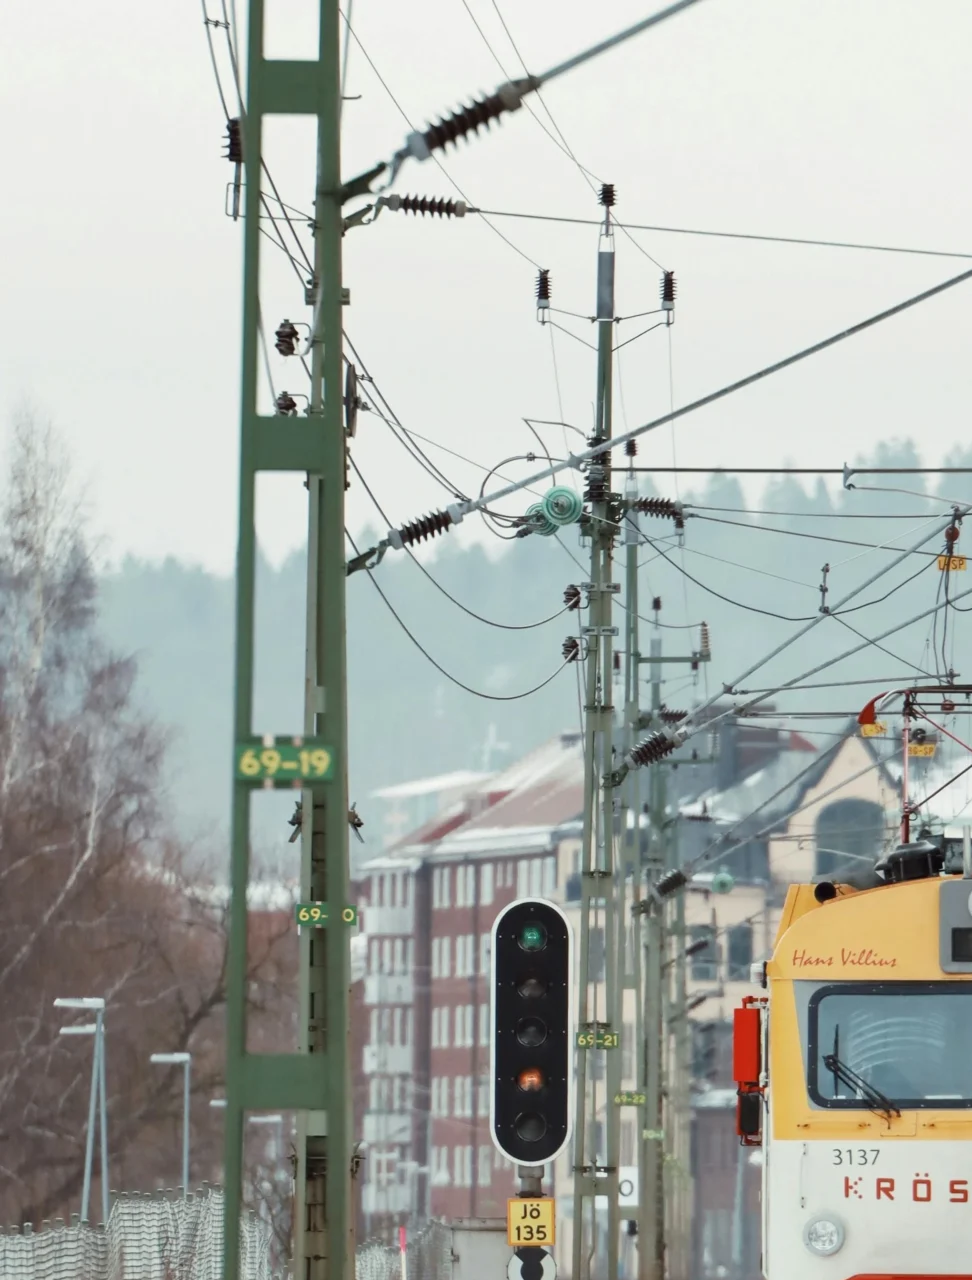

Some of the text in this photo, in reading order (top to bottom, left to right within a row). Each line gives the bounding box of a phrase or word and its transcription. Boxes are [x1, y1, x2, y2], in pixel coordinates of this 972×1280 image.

[239, 748, 331, 776] 69-19
[299, 907, 355, 923] 69-0
[792, 947, 897, 968] Hans Villius
[578, 1034, 618, 1047] 69-21
[614, 1095, 646, 1104] 69-22
[832, 1148, 881, 1166] 3137
[521, 1204, 541, 1220] Jö
[515, 1225, 547, 1241] 135
